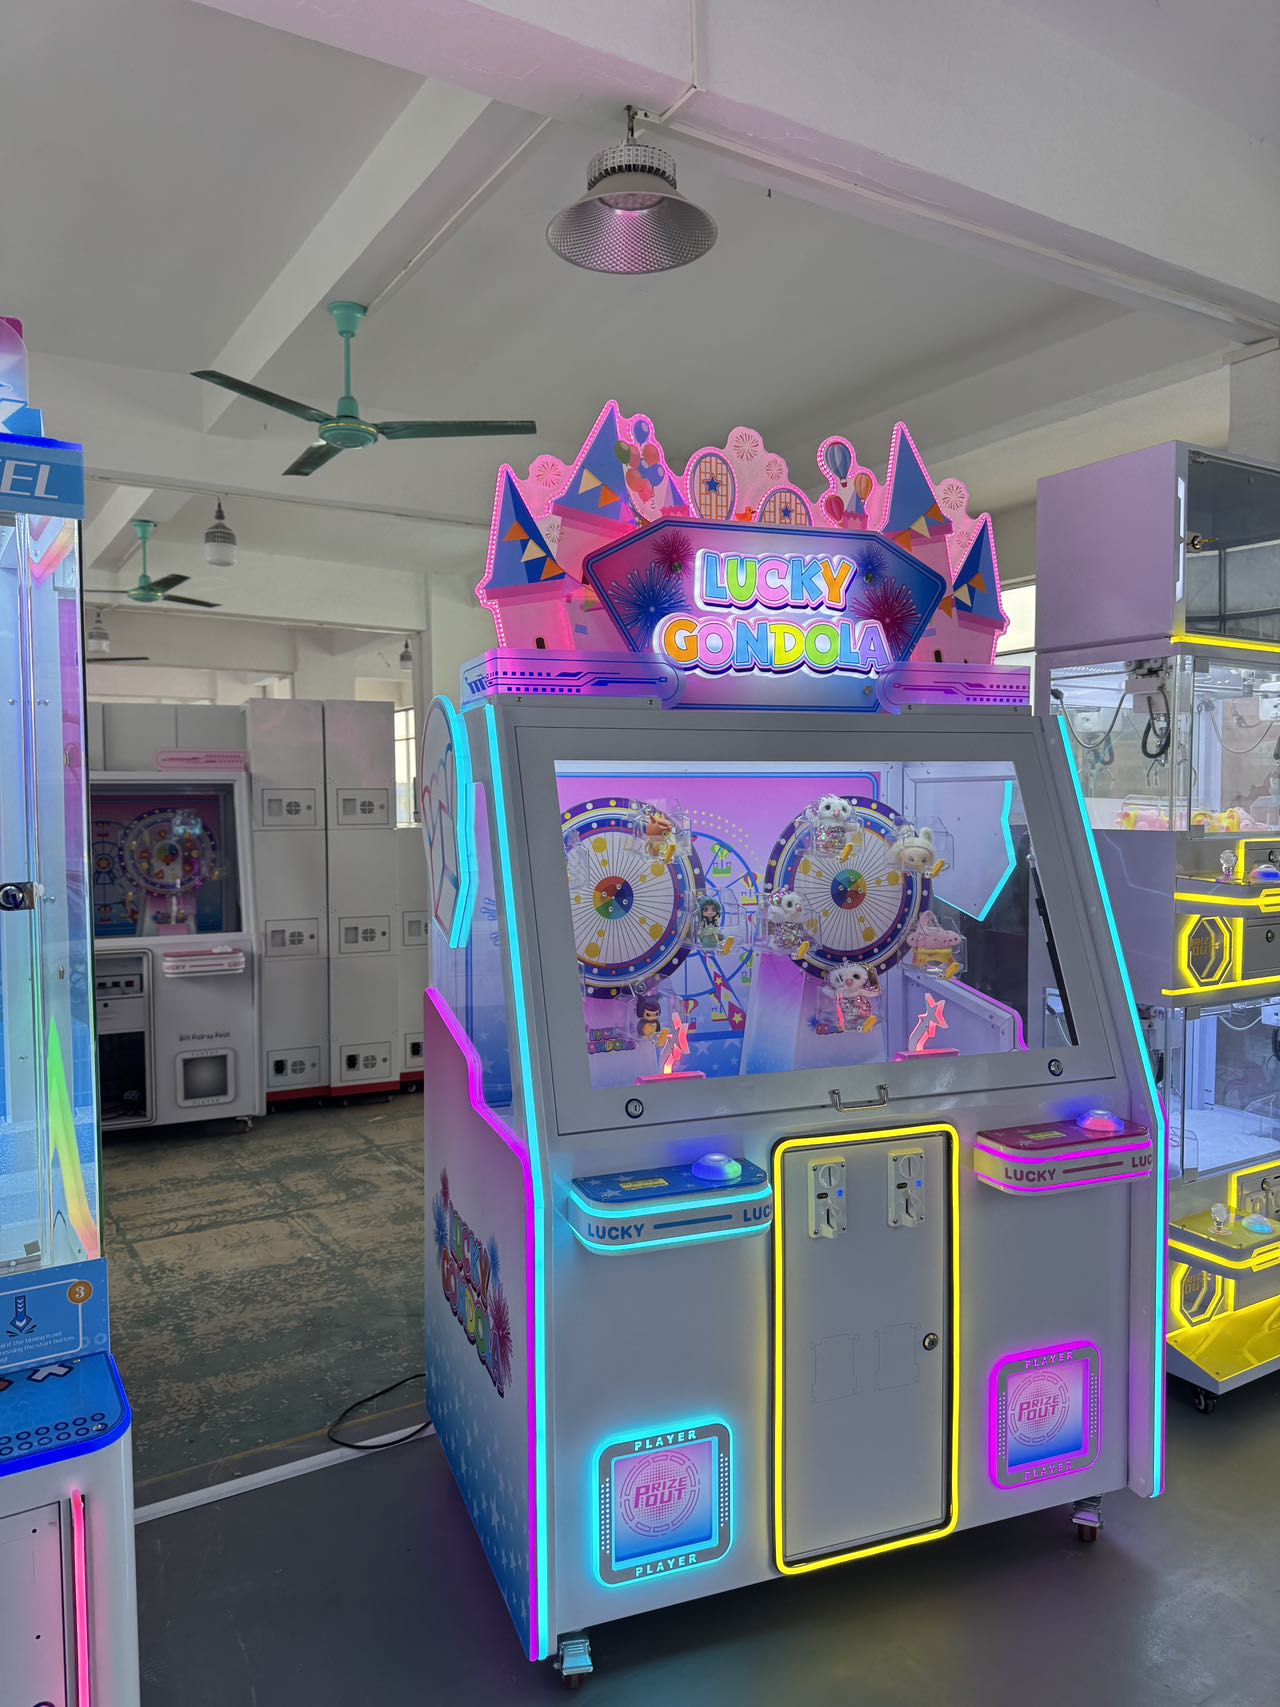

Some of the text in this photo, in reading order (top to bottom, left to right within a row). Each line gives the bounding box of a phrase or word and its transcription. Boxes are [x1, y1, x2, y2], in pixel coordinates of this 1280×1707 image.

[0, 459, 58, 499] EL
[699, 551, 856, 611] LUCKY
[658, 615, 894, 674] GONDOLA
[1004, 1167, 1057, 1183] LUCKY
[588, 1222, 645, 1241] LUCKY
[75, 1285, 85, 1299] 3
[1025, 1351, 1073, 1369] PLAYER
[1017, 1394, 1061, 1422] PRIZE
[1026, 1403, 1060, 1421] OUT
[634, 1430, 697, 1451] PLAYER
[1024, 1461, 1073, 1480] PLAYER
[633, 1475, 688, 1509] PRIZE
[644, 1487, 687, 1508] OUT
[635, 1553, 698, 1577] PLAYER
